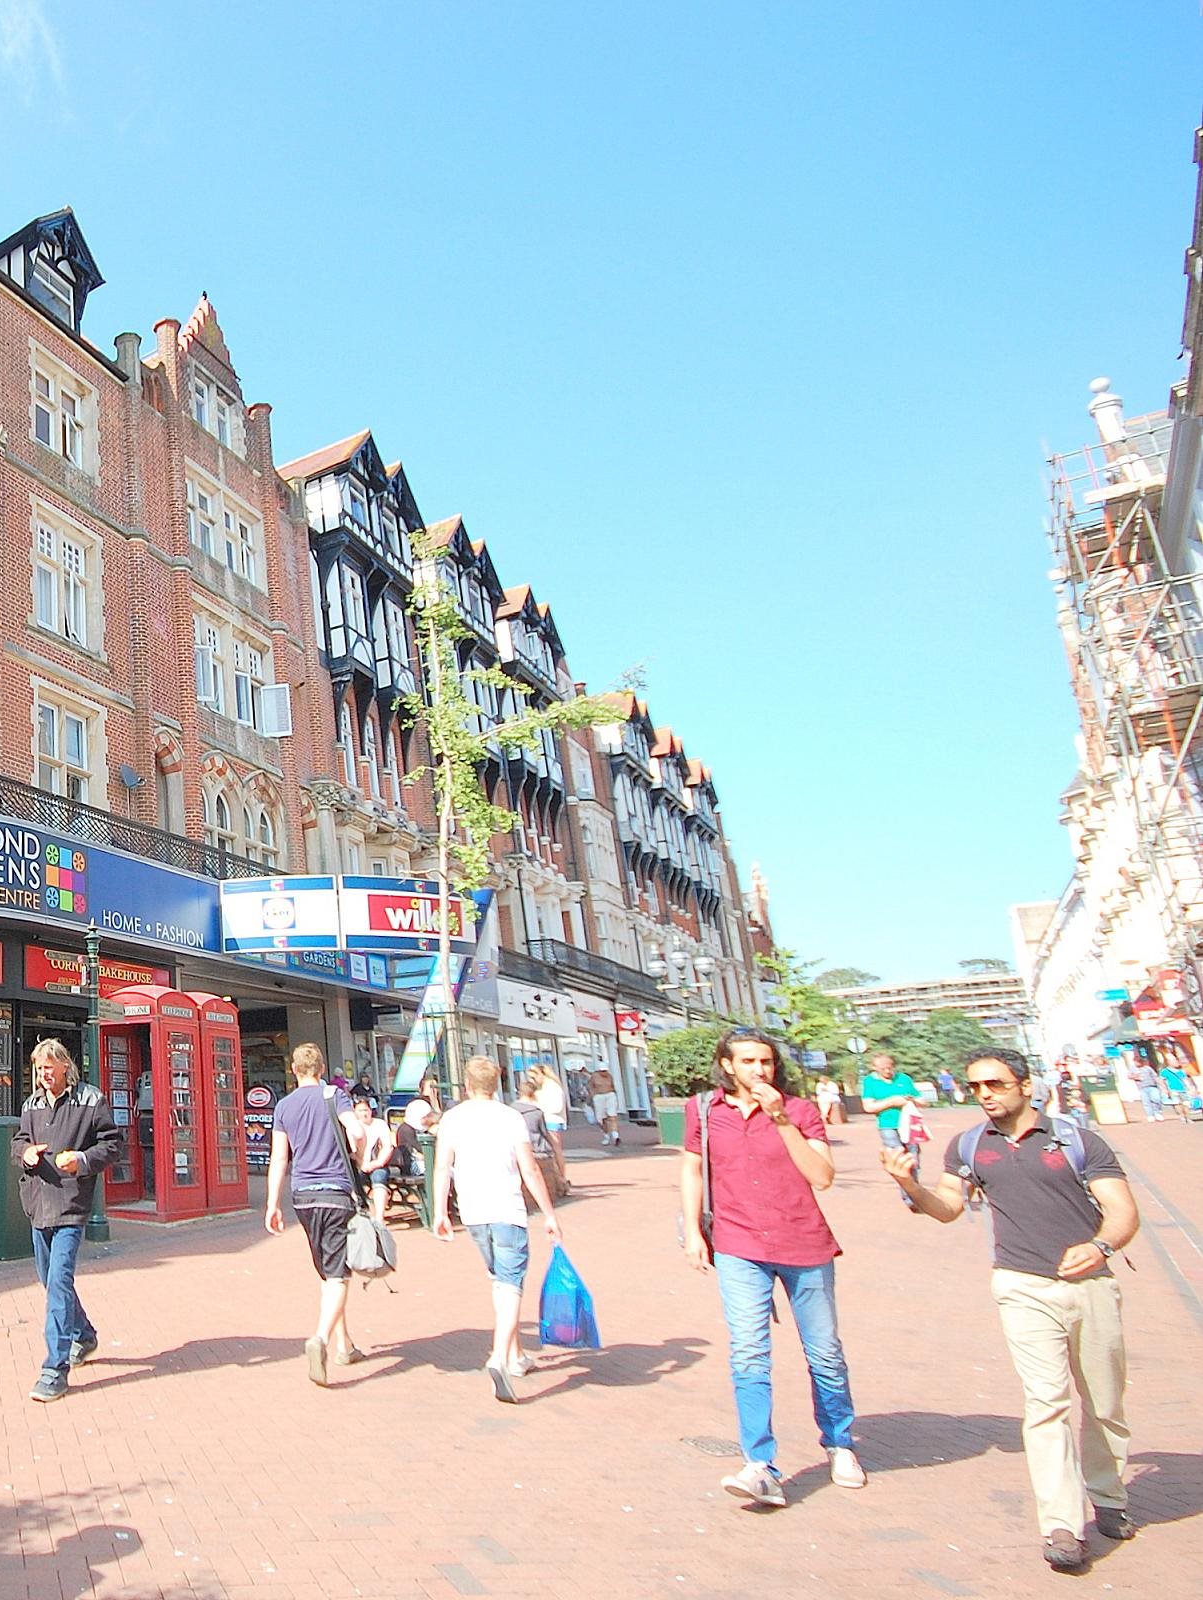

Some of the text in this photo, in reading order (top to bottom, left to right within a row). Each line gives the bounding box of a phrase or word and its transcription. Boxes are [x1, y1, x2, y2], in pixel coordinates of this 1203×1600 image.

[102, 909, 204, 948] HOME FASHION
[385, 898, 449, 934] wilk
[303, 951, 336, 969] GARDENS
[99, 966, 153, 984] BAKEHOUSE
